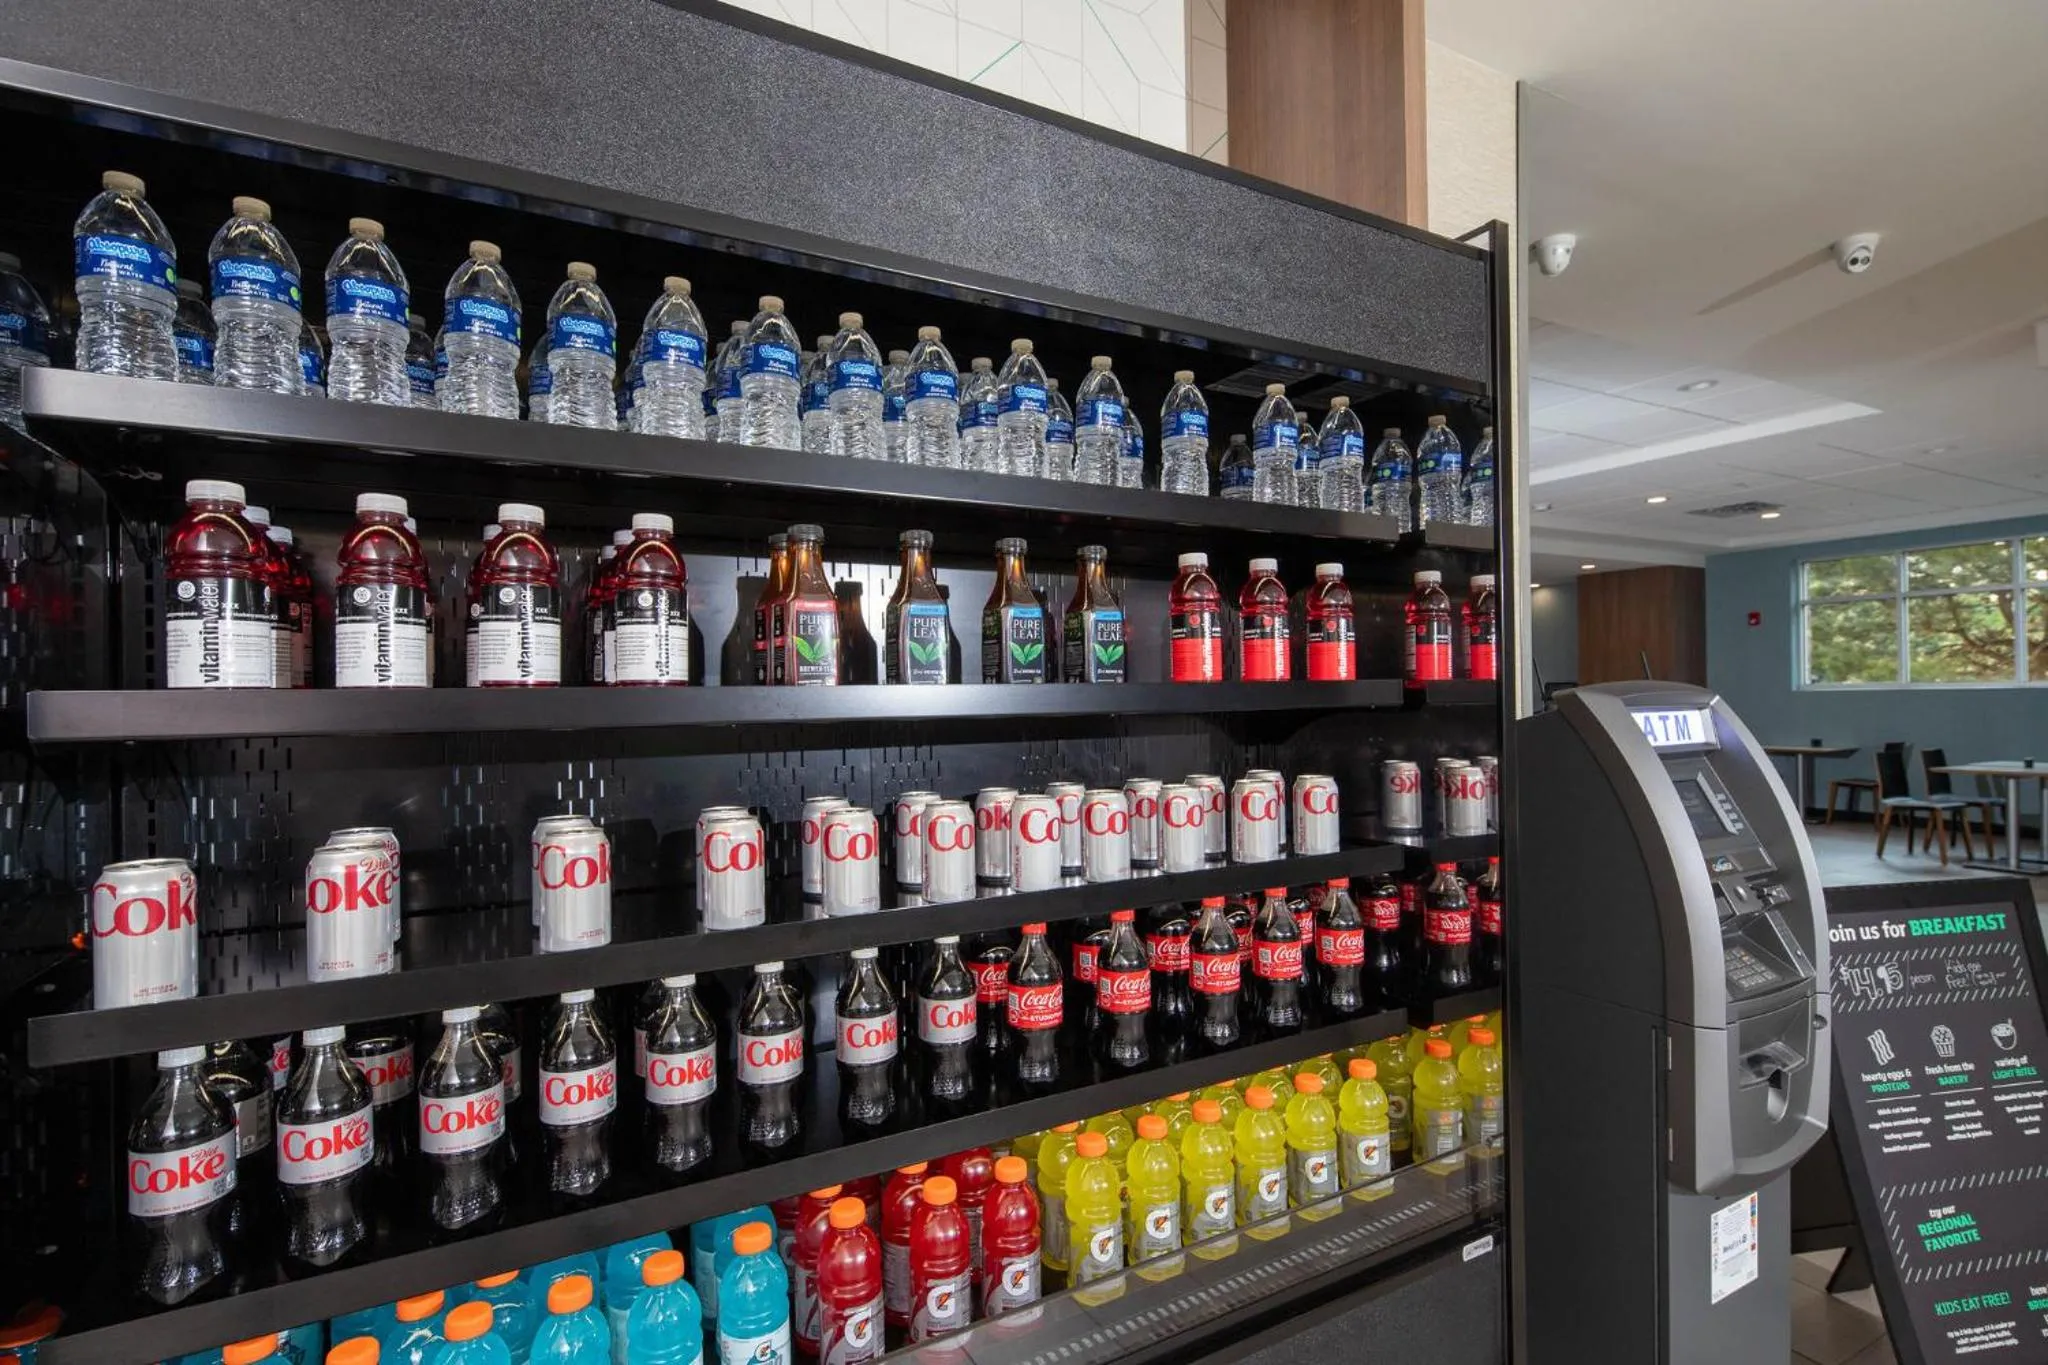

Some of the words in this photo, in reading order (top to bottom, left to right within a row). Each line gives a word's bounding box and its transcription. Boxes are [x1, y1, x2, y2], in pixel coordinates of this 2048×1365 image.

[199, 578, 219, 683] vitaminwater
[800, 625, 833, 636] LEA
[1013, 619, 1040, 630] PURE
[1013, 629, 1040, 640] LEAF
[1098, 622, 1122, 632] PURE
[1098, 631, 1123, 641] LEAF
[1642, 714, 1692, 743] ATM
[539, 842, 613, 890] Cok
[306, 864, 394, 914] oke
[91, 880, 198, 938] Cok
[1829, 924, 1857, 943] oin
[1860, 925, 1880, 941] us
[1881, 920, 1906, 938] for
[1908, 914, 2006, 936] BREAKFAST
[650, 1055, 714, 1088] Coke
[1961, 1061, 1976, 1072] the
[545, 1071, 614, 1106] Coke
[423, 1099, 502, 1134] Coke
[283, 1119, 369, 1162] Coke
[130, 1152, 226, 1194] Coke
[1917, 1213, 1977, 1237] REGIONAL
[1928, 1207, 1942, 1219] try
[1942, 1204, 1957, 1214] our
[1923, 1228, 1982, 1253] FAVORITE
[1935, 1301, 1961, 1316] KIDS
[1962, 1296, 1981, 1312] EAT
